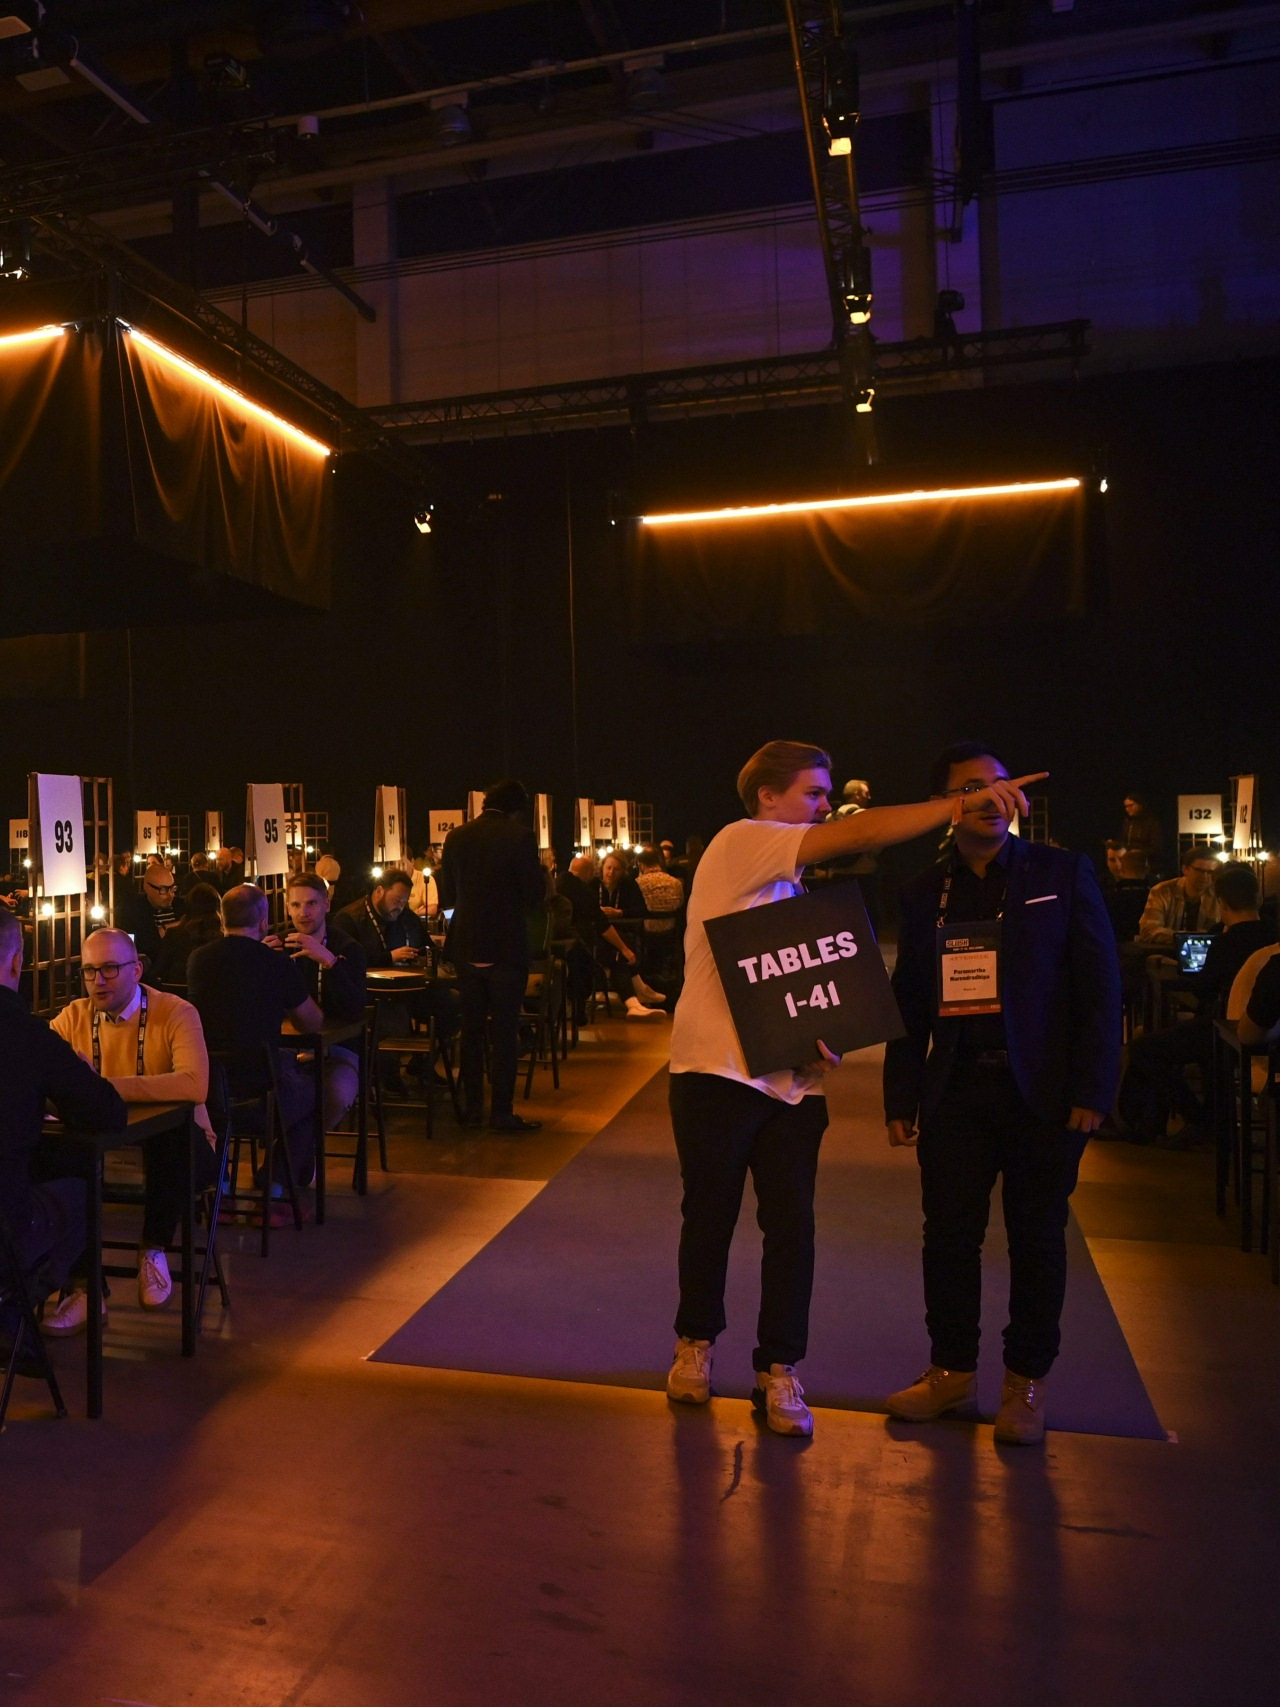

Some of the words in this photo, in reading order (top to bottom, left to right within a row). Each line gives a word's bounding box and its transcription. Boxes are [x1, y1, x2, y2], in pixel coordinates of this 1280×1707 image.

[1188, 809, 1212, 820] 132
[437, 822, 455, 831] 124
[600, 818, 613, 828] 12
[16, 830, 29, 838] 118
[54, 820, 74, 854] 93
[143, 827, 152, 839] 85
[264, 818, 279, 844] 95
[737, 931, 858, 984] TABLES
[784, 980, 841, 1018] 1-41
